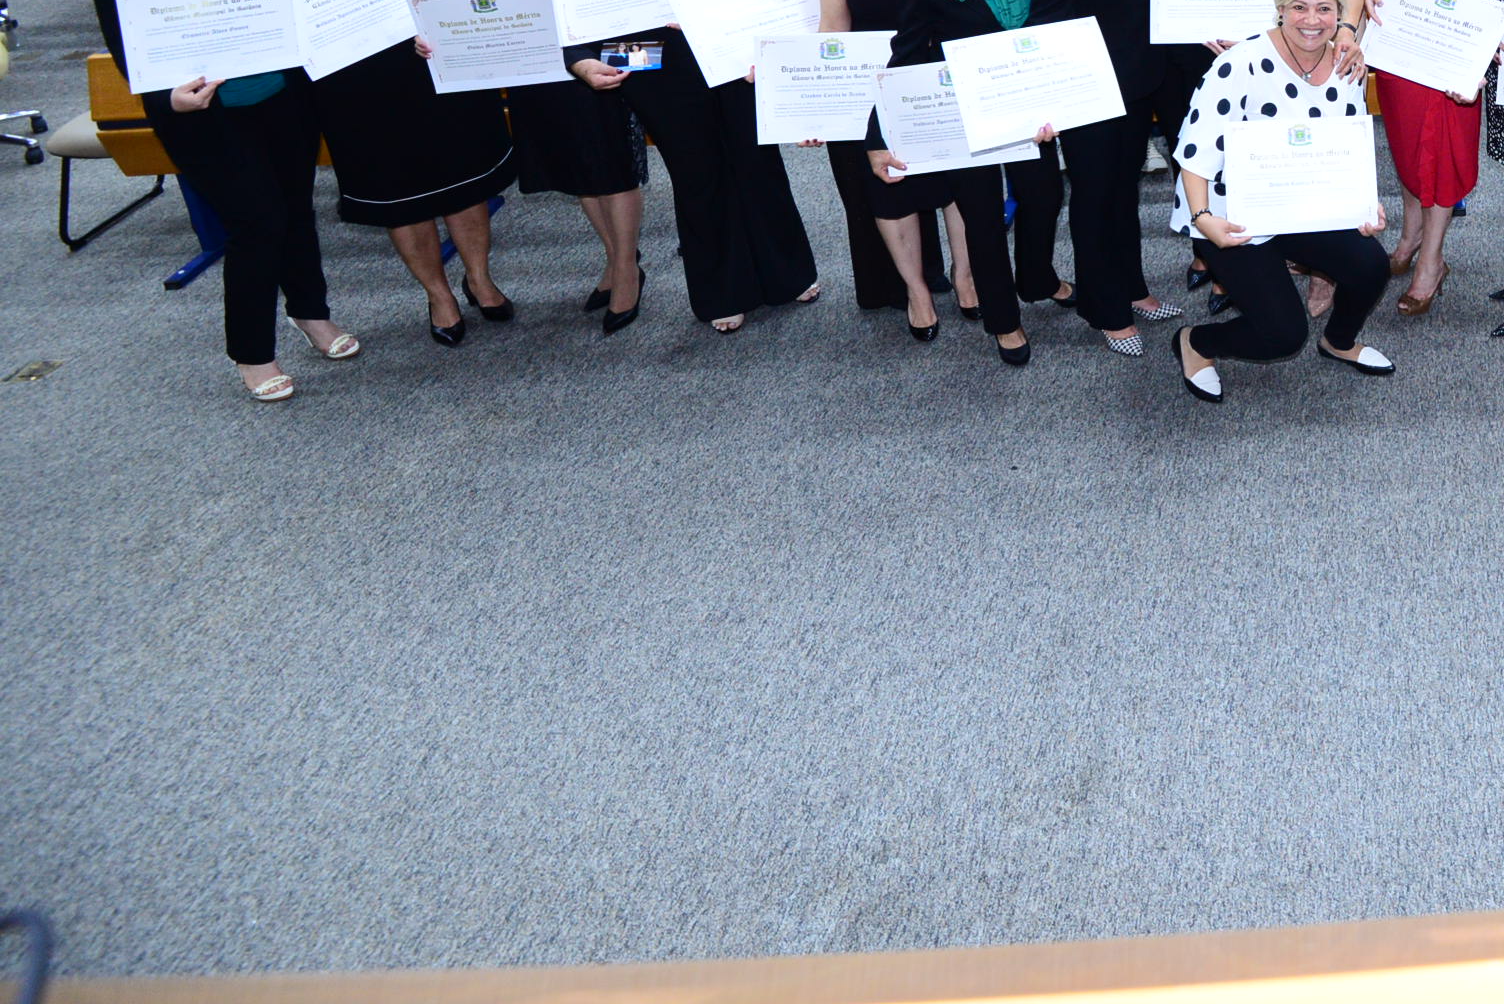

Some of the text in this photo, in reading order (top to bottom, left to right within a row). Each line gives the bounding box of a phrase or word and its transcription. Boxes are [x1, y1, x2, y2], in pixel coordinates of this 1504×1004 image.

[439, 19, 468, 29] Diploma
[781, 65, 811, 74] Diploma
[825, 64, 847, 72] Honra
